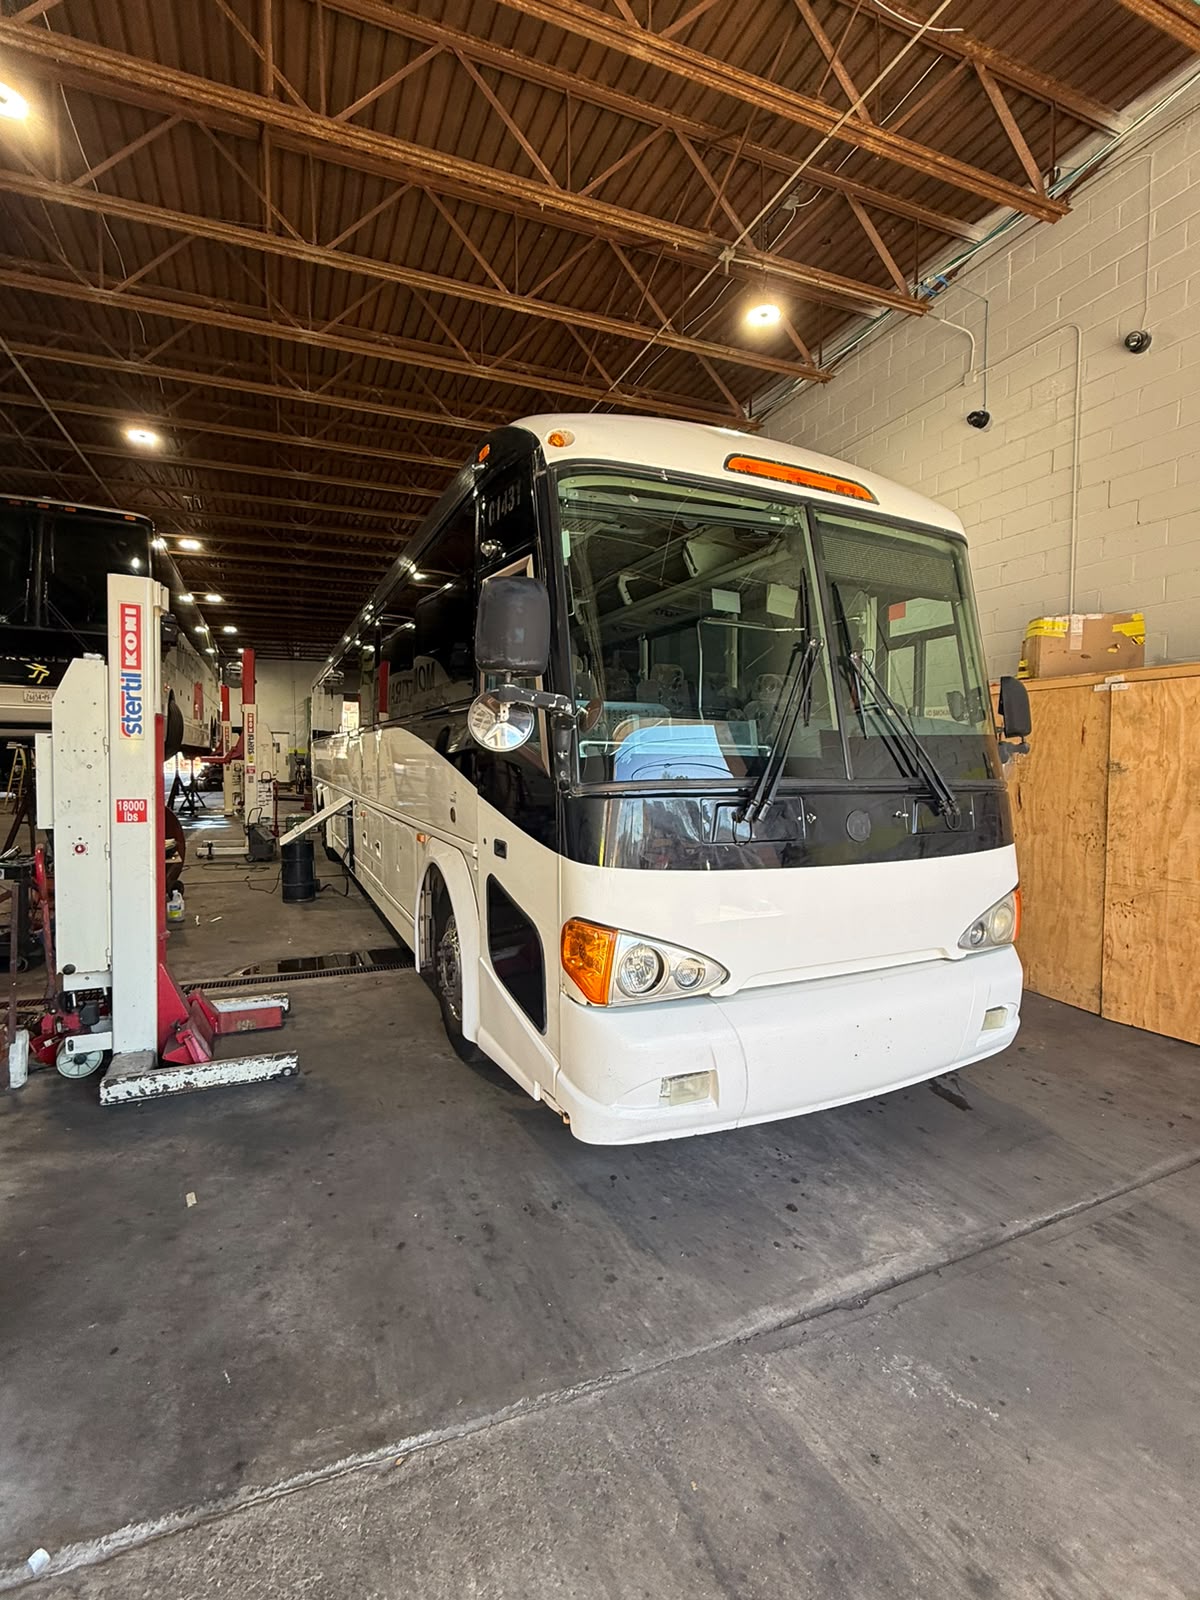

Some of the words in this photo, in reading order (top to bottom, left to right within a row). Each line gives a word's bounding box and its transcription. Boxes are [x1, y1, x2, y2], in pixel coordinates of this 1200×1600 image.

[125, 608, 137, 667] KONI
[121, 673, 142, 737] stertil
[118, 801, 144, 811] 18000
[124, 812, 139, 822] lbs
